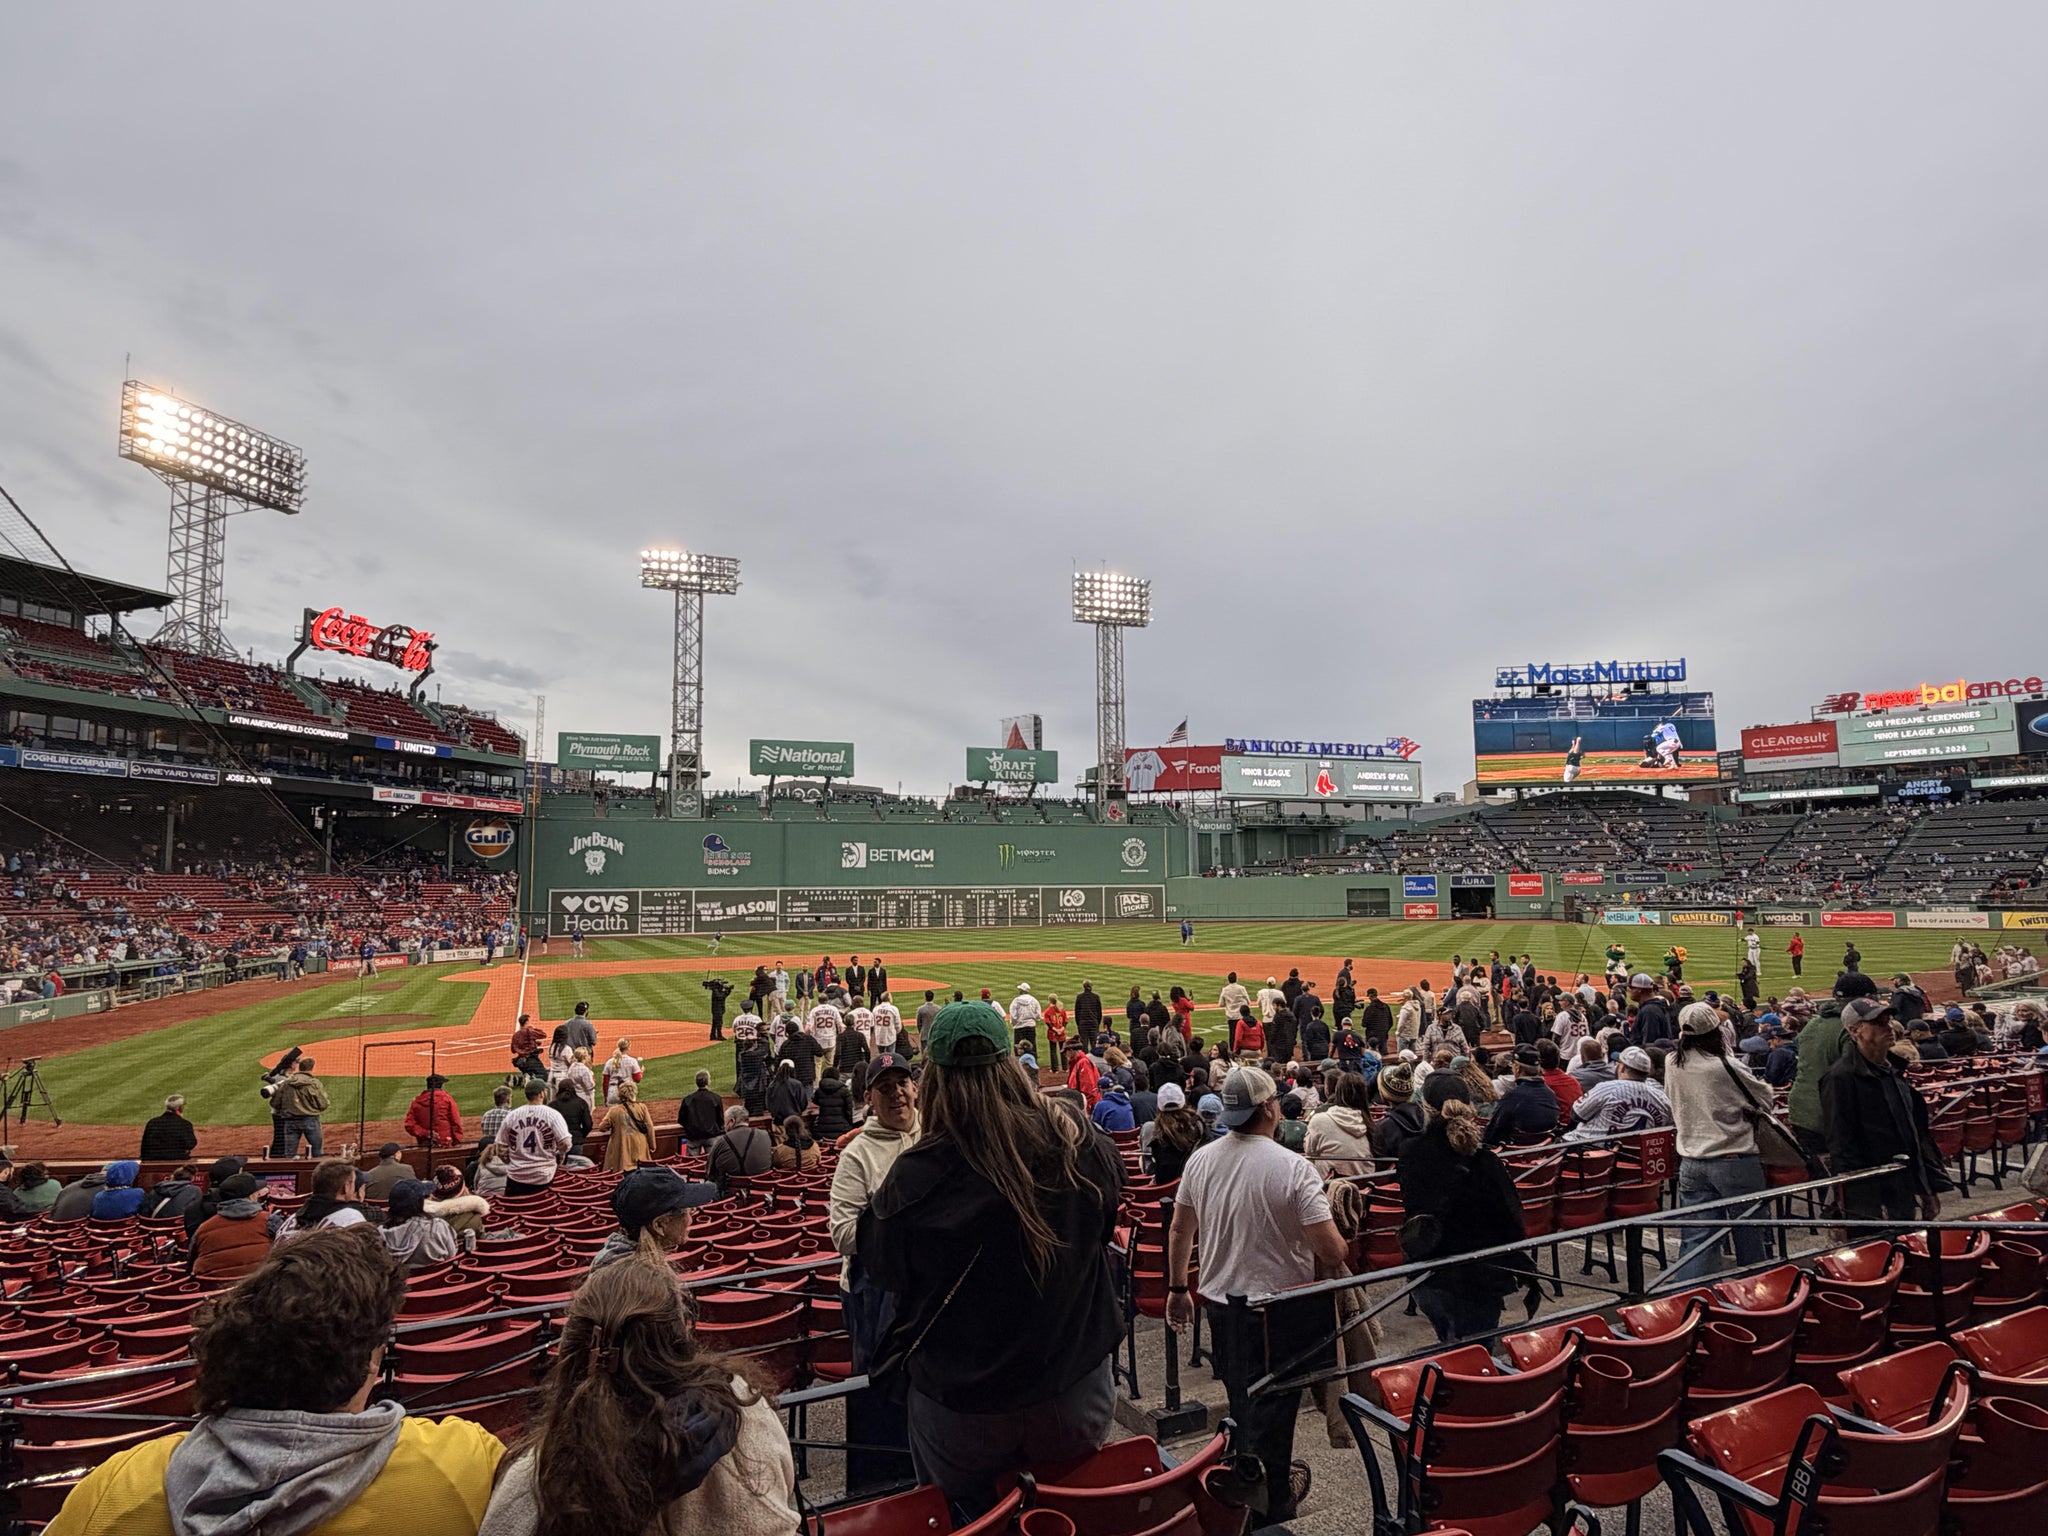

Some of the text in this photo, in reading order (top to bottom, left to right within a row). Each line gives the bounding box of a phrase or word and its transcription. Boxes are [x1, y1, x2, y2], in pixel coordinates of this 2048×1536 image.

[1528, 658, 1686, 684] MassMutual
[1864, 677, 2043, 710] new balance
[1866, 710, 1981, 728] OUR PREGAME CEREMONIES
[229, 715, 249, 726] LATIN
[303, 726, 349, 740] COORDINATOR
[1874, 725, 1975, 740] MINOR LEAGUE AWARDS
[1752, 731, 1828, 749] CLEAResult
[403, 741, 437, 755] UNITED
[569, 742, 649, 756] Plymouth Rock
[1225, 739, 1385, 757] BANK OF AMERICA
[1884, 748, 1928, 758] SEPTEMBER
[24, 752, 69, 764] COGHLIN
[69, 755, 126, 769] COMPANIES
[802, 763, 816, 771] Car
[988, 761, 1036, 772] DRAFT
[141, 766, 217, 781] VINEYARD VINES
[225, 773, 245, 783] JOSE
[994, 771, 1035, 780] KINGS
[1241, 767, 1291, 777] MINOR LEAGUE
[1252, 778, 1282, 787] AWARDS
[1906, 780, 1942, 789] ANGRY
[1898, 786, 1952, 796] ORCHARD
[1199, 822, 1232, 831] ABIOMED
[467, 829, 512, 844] Gulf
[569, 832, 625, 856] JIM BEAM
[870, 849, 934, 862] BETMGM
[1016, 849, 1056, 858] MONSTER
[707, 867, 731, 875] BIDMC
[1510, 880, 1543, 888] Safelite
[583, 895, 629, 914] CVS
[1059, 889, 1085, 907] 160
[1122, 894, 1149, 905] ACE
[726, 900, 776, 915] MASON
[1123, 903, 1149, 913] TICKET
[563, 914, 629, 932] Health
[1671, 912, 1709, 923] GRANITE
[1709, 911, 1729, 923] CITY
[1765, 912, 1804, 922] wasabi
[816, 1016, 834, 1029] 26
[856, 1019, 870, 1031] 26
[875, 1015, 891, 1026] 26
[1570, 1024, 1587, 1037] 33
[2029, 1094, 2041, 1107] 34
[523, 1131, 536, 1153] 4
[1646, 1137, 1665, 1146] FIELD
[1646, 1158, 1666, 1175] 36
[1417, 1405, 1428, 1425] AA
[1791, 1467, 1811, 1497] BB
